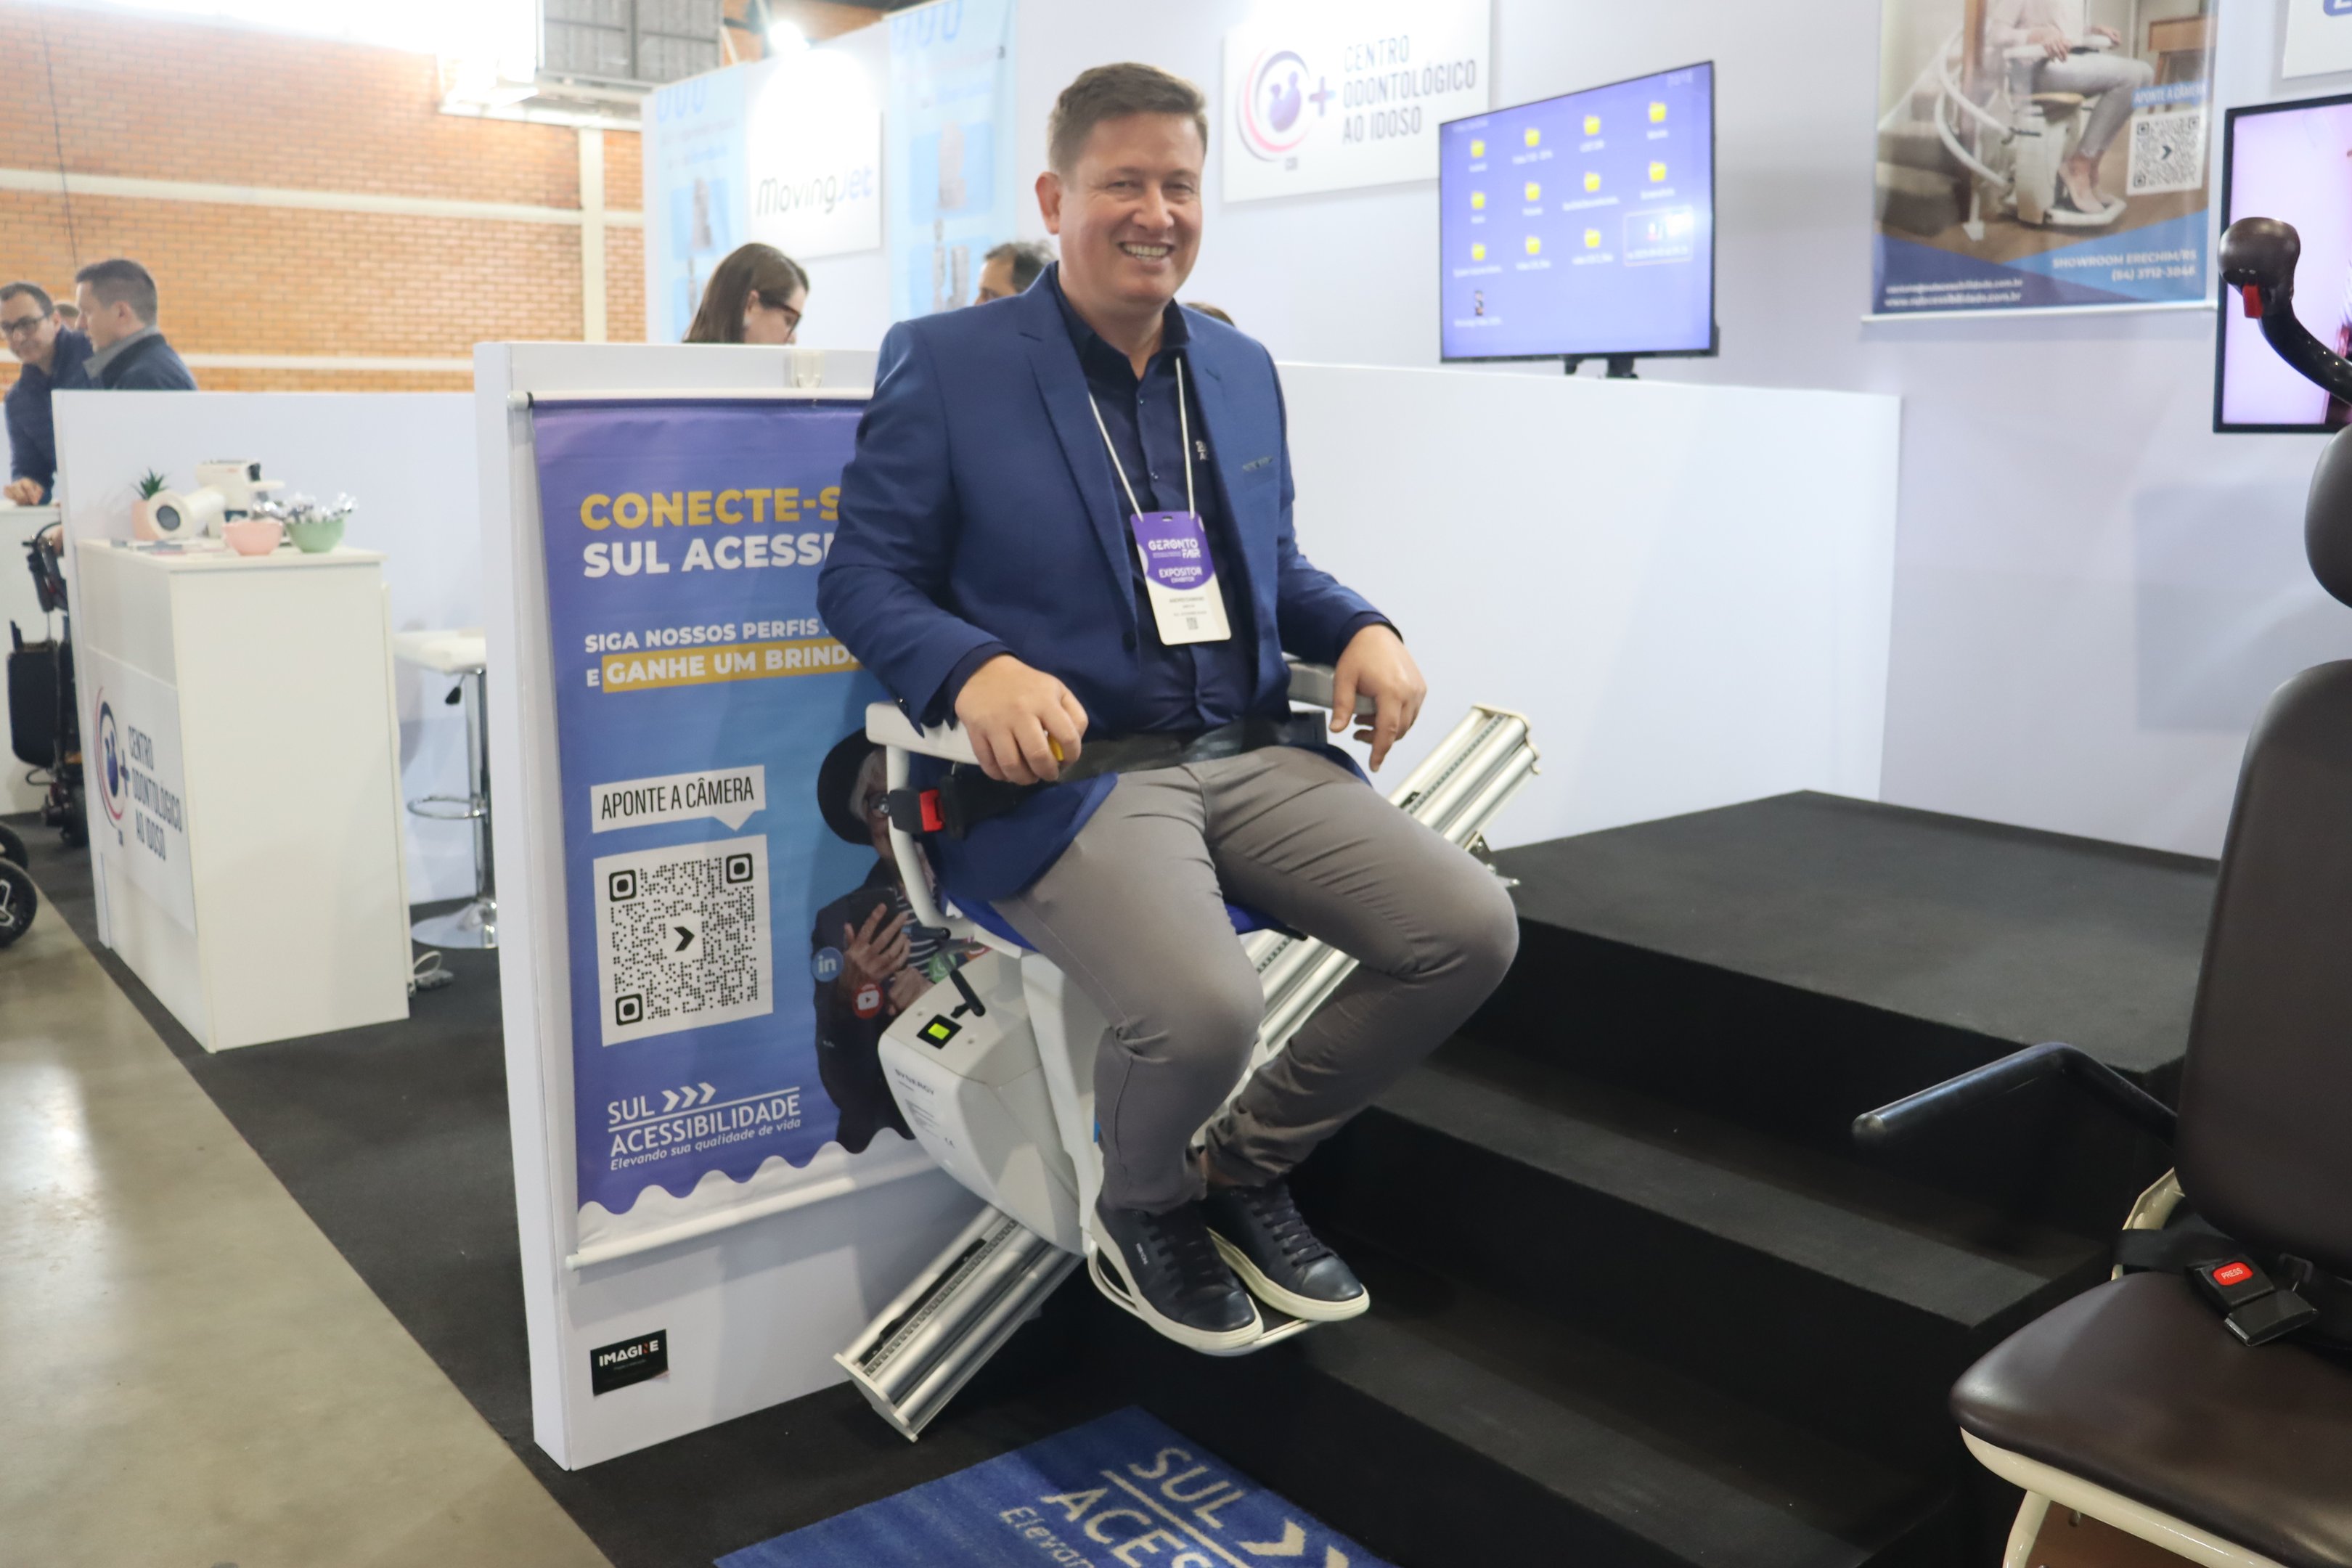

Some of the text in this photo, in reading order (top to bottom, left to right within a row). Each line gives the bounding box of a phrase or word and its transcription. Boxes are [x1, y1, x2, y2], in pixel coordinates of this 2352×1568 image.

[1344, 35, 1410, 73] CENTRO
[1343, 59, 1477, 109] ODONTOLÓGICO
[1342, 115, 1365, 144] AO
[1370, 106, 1422, 140] IDOSO
[584, 541, 670, 578] SUL
[1159, 567, 1202, 579] EXPOSITOR
[585, 618, 820, 653] SIGA NOSSOS PERFIS
[587, 643, 859, 687] E GANHE UM BRIND
[128, 726, 153, 770] CENTRO
[601, 777, 755, 820] APONTE A CÂMERA
[608, 1095, 655, 1125] SUL
[611, 1094, 801, 1157] ACESSIBILIDADE
[611, 1118, 801, 1171] Elevando sua qualidade de vida
[2221, 1267, 2243, 1279] PRESS
[1127, 1447, 1246, 1530] SUL
